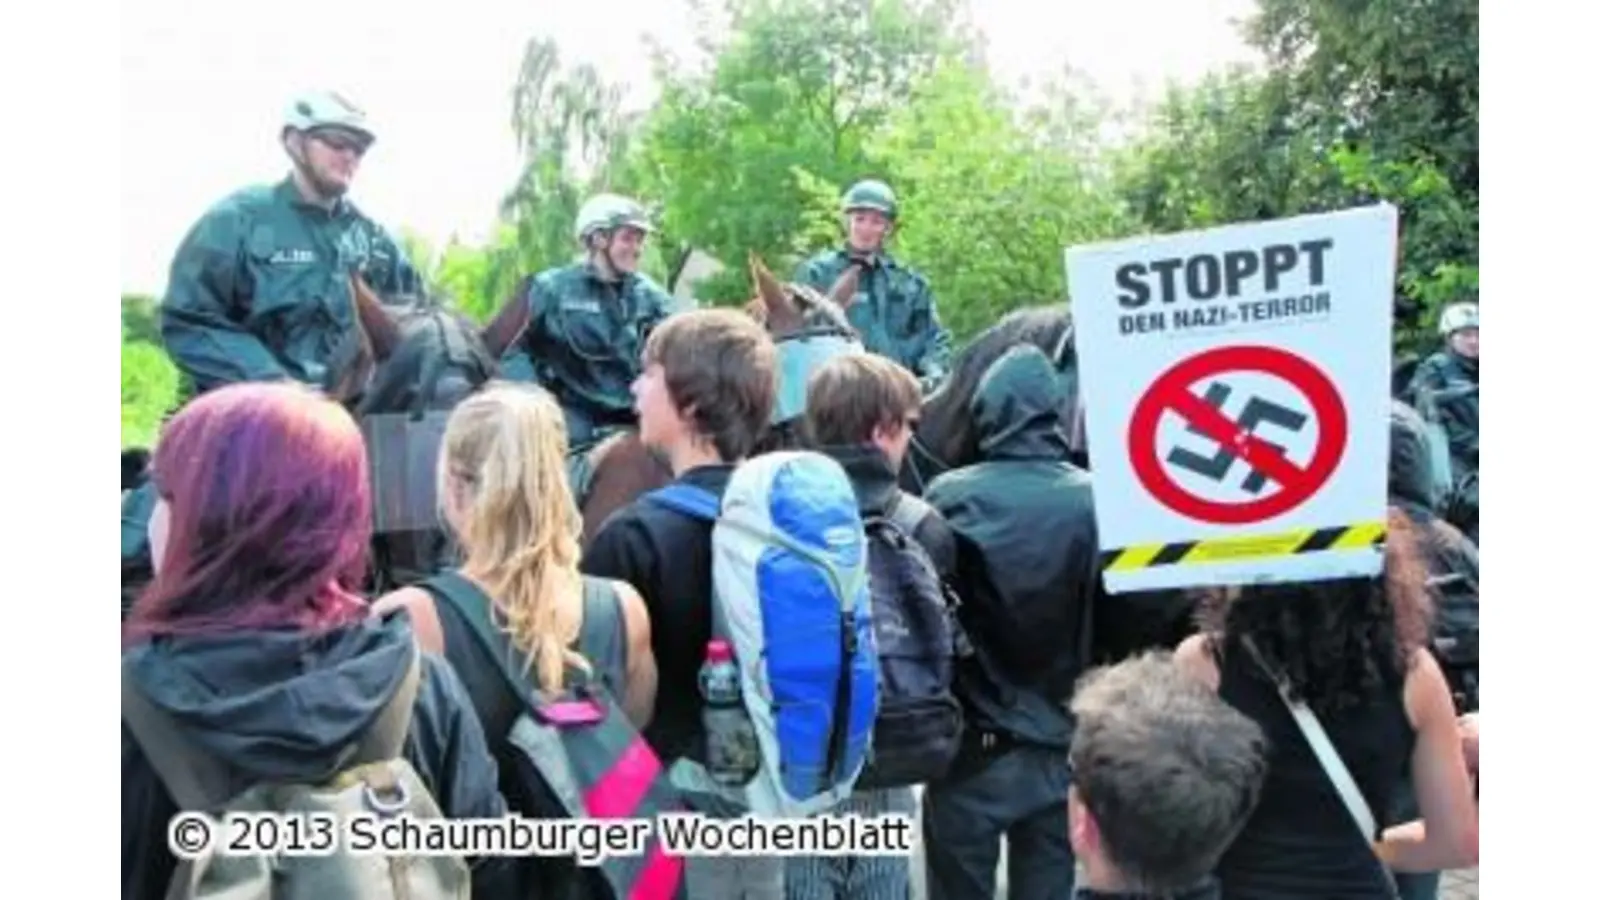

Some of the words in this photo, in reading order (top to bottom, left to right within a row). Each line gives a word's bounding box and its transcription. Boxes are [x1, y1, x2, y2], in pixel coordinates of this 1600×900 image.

[1115, 238, 1334, 309] STOPPT
[1119, 312, 1166, 335] DEN
[1173, 291, 1332, 330] NAZI-TERROR
